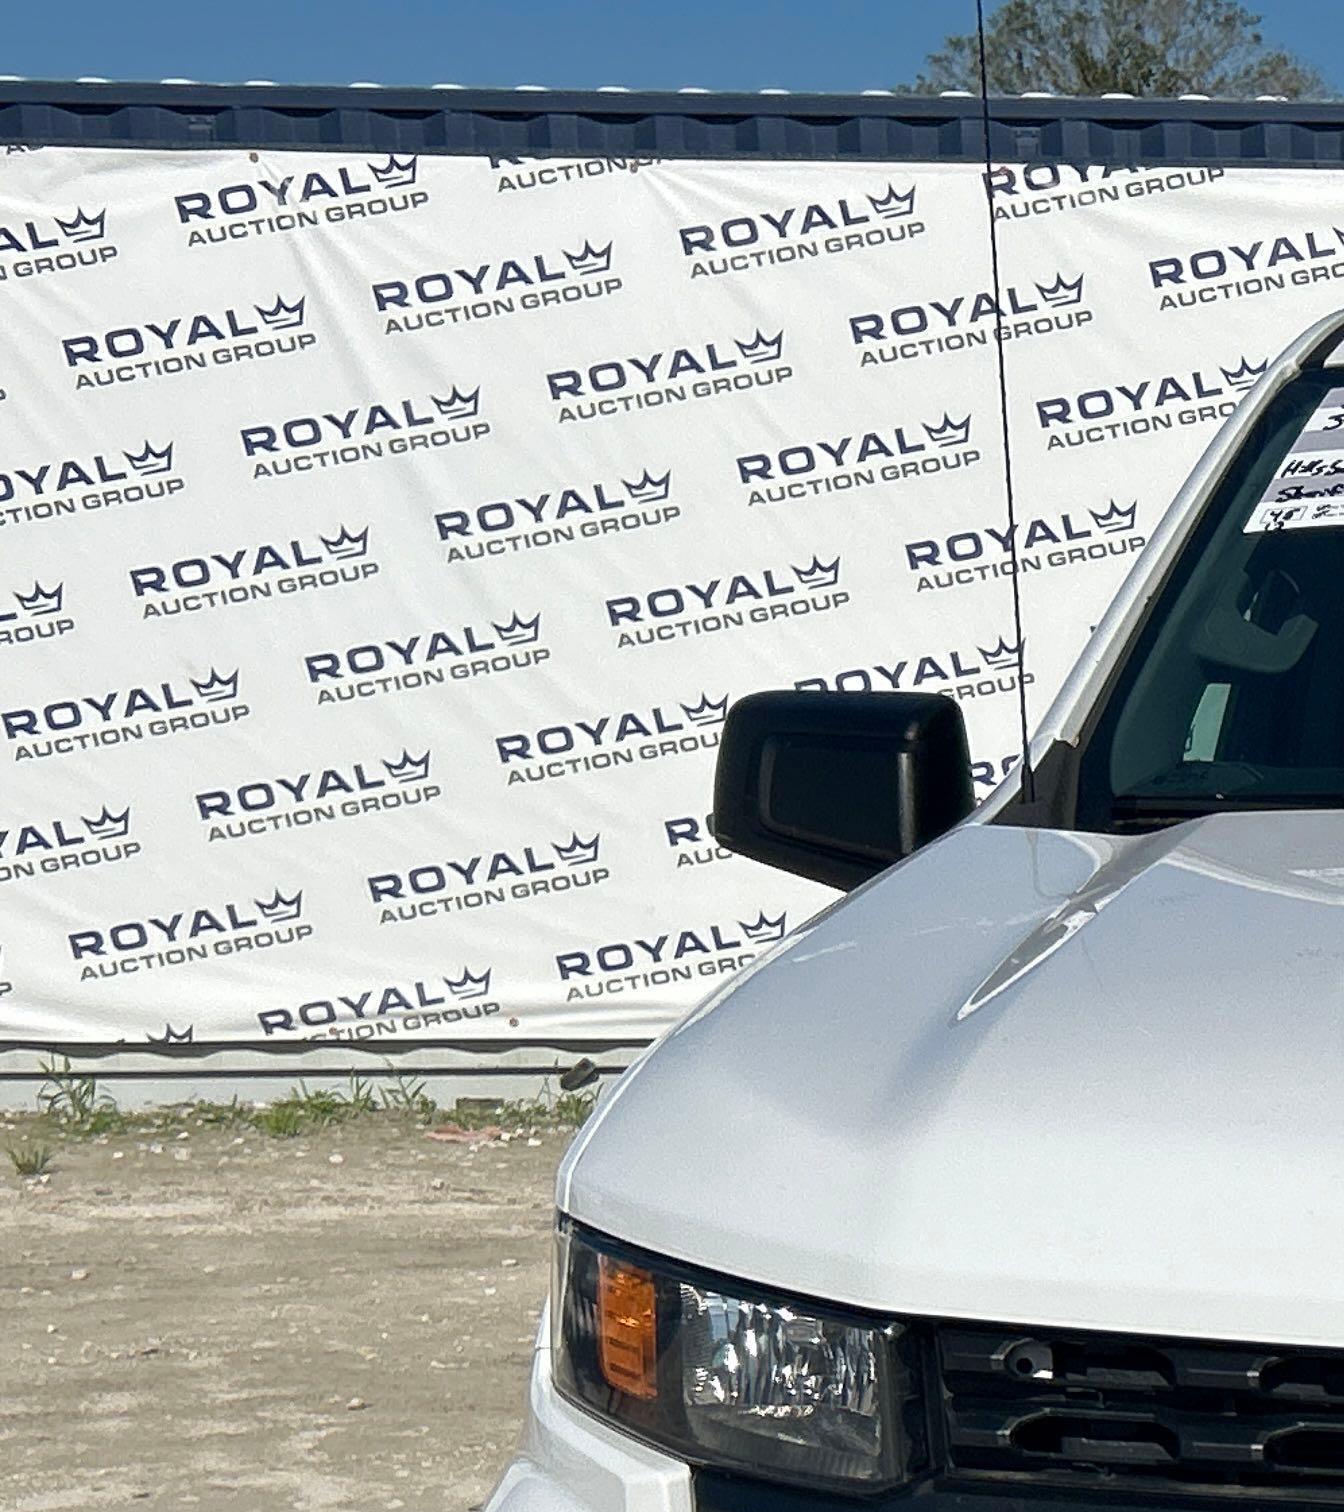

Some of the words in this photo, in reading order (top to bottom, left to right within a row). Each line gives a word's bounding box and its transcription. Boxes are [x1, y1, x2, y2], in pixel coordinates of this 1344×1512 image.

[174, 167, 372, 223] ROYAL
[188, 210, 319, 246] AUCTION
[324, 192, 428, 222] GROUP
[992, 186, 1119, 222] AUCTION
[1124, 167, 1224, 198] GROUP
[678, 199, 871, 256] ROYAL
[691, 241, 819, 279] AUCTION
[824, 222, 925, 253] GROUP
[13, 246, 118, 278] GROUP
[372, 255, 567, 312] ROYAL
[1148, 233, 1337, 288] ROYAL
[385, 297, 515, 335] AUCTION
[520, 278, 622, 309] GROUP
[849, 288, 1039, 344] ROYAL
[1160, 273, 1285, 309] AUCTION
[61, 310, 259, 367] ROYAL
[76, 352, 207, 390] AUCTION
[212, 333, 315, 365] GROUP
[861, 330, 987, 367] AUCTION
[992, 310, 1092, 341] GROUP
[546, 344, 738, 400] ROYAL
[559, 386, 686, 423] AUCTION
[692, 366, 792, 398] GROUP
[1036, 372, 1223, 428] ROYAL
[240, 400, 435, 456] ROYAL
[254, 442, 383, 479] AUCTION
[388, 423, 490, 454] GROUP
[736, 428, 926, 484] ROYAL
[1047, 413, 1172, 450] AUCTION
[82, 480, 185, 511] GROUP
[748, 469, 875, 507] AUCTION
[880, 450, 980, 481] GROUP
[434, 484, 626, 541] ROYAL
[447, 526, 574, 563] AUCTION
[579, 506, 680, 537] GROUP
[129, 540, 324, 596] ROYAL
[905, 514, 1093, 570] ROYAL
[917, 555, 1042, 592] AUCTION
[1047, 536, 1146, 567] GROUP
[143, 582, 272, 619] AUCTION
[277, 563, 379, 594] GROUP
[605, 570, 795, 626] ROYAL
[618, 611, 744, 649] AUCTION
[749, 592, 849, 623] GROUP
[304, 627, 496, 683] ROYAL
[318, 668, 445, 705] AUCTION
[450, 648, 550, 679] GROUP
[1, 683, 194, 739] ROYAL
[15, 724, 143, 761] AUCTION
[148, 705, 249, 736] GROUP
[495, 708, 684, 763] ROYAL
[195, 764, 386, 820] ROYAL
[508, 748, 633, 785] AUCTION
[209, 805, 335, 842] AUCTION
[340, 785, 440, 816] GROUP
[41, 840, 141, 874] GROUP
[367, 847, 556, 903] ROYAL
[380, 888, 505, 924] AUCTION
[510, 868, 609, 899] GROUP
[68, 904, 259, 959] ROYAL
[82, 944, 208, 981] AUCTION
[213, 925, 313, 956] GROUP
[555, 926, 742, 980] ROYAL
[257, 981, 446, 1035] ROYAL
[568, 965, 692, 1001] AUCTION
